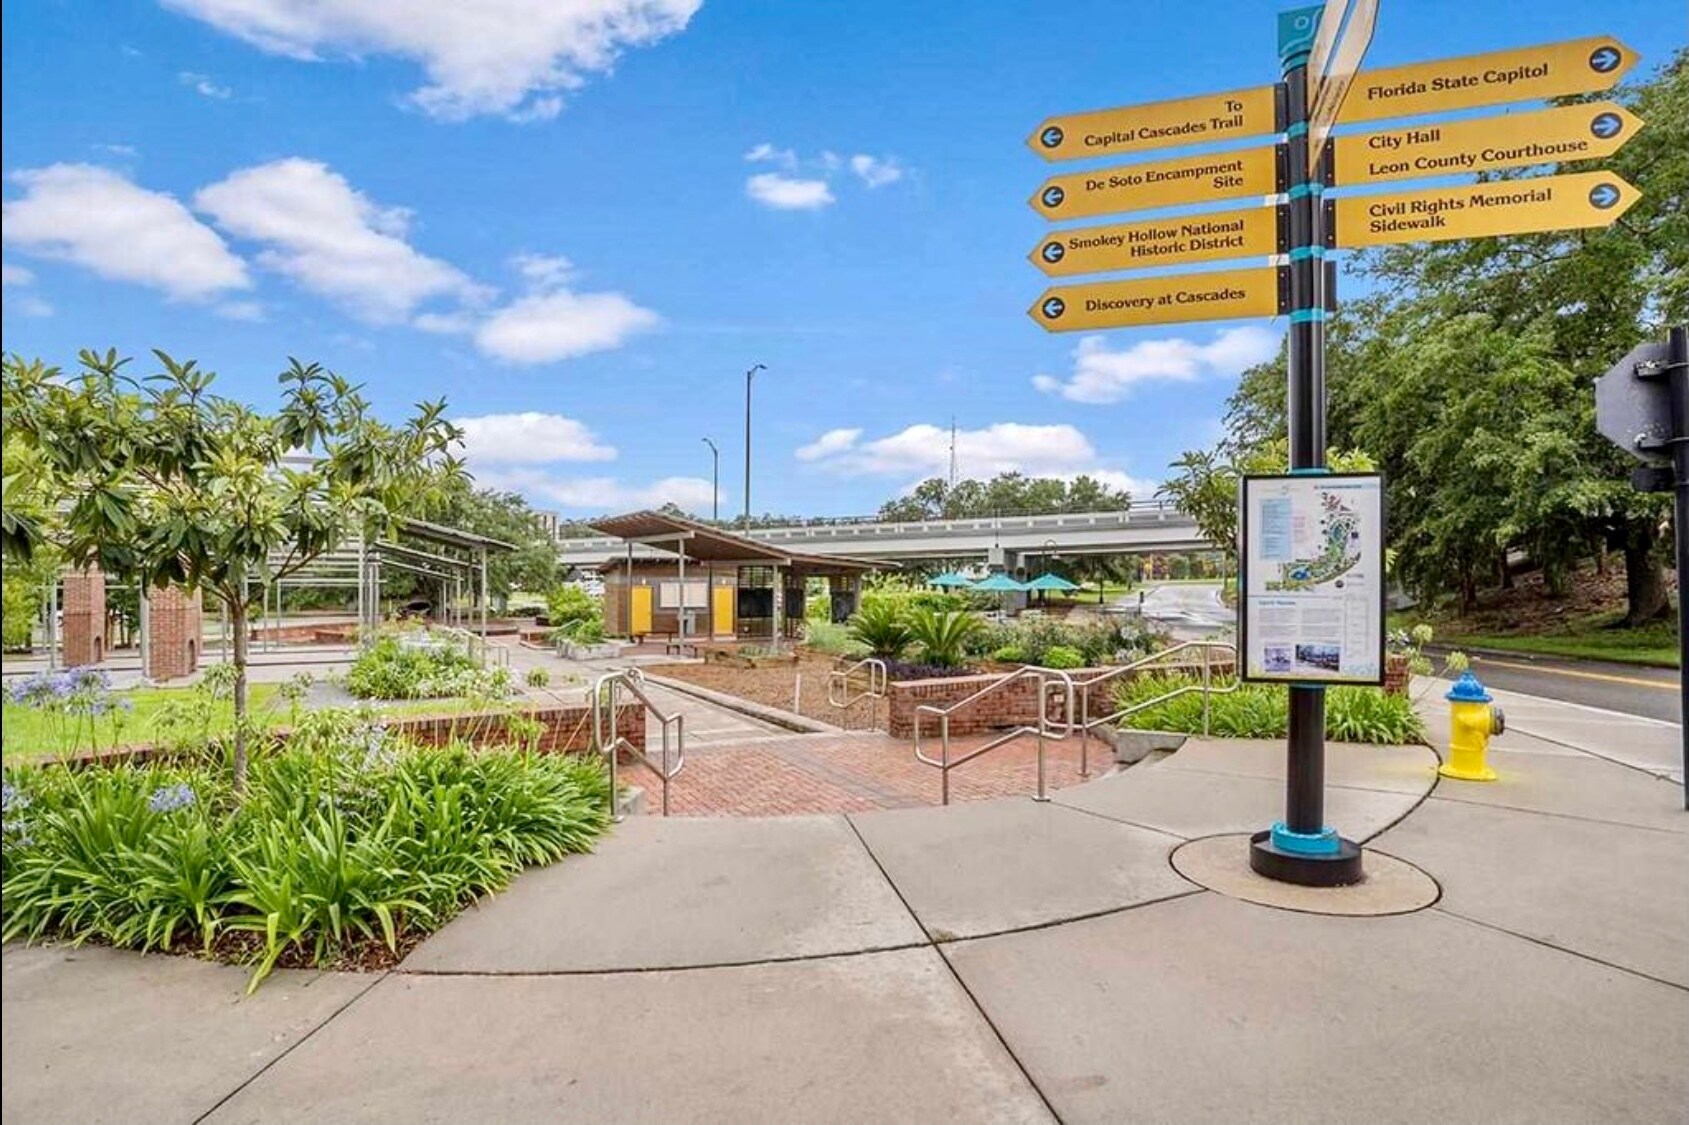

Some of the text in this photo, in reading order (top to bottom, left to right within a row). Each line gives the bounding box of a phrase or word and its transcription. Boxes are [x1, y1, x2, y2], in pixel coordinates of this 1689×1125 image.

[1368, 64, 1549, 100] Florida State Capitol
[1225, 100, 1242, 112] To
[1085, 116, 1243, 147] Capital Cascades Trail
[1368, 129, 1440, 150] City Hall
[1369, 141, 1588, 175] Leon County Courthouse
[1086, 161, 1242, 191] De Soto Encampment
[1213, 176, 1243, 188] Site
[1369, 189, 1552, 217] Civil Rights Memorial
[1069, 220, 1244, 250] Smokey Hollow National
[1370, 217, 1446, 233] Sidewalk
[1130, 236, 1244, 257] Historic District
[1086, 288, 1245, 311] Discovery at Cascades
